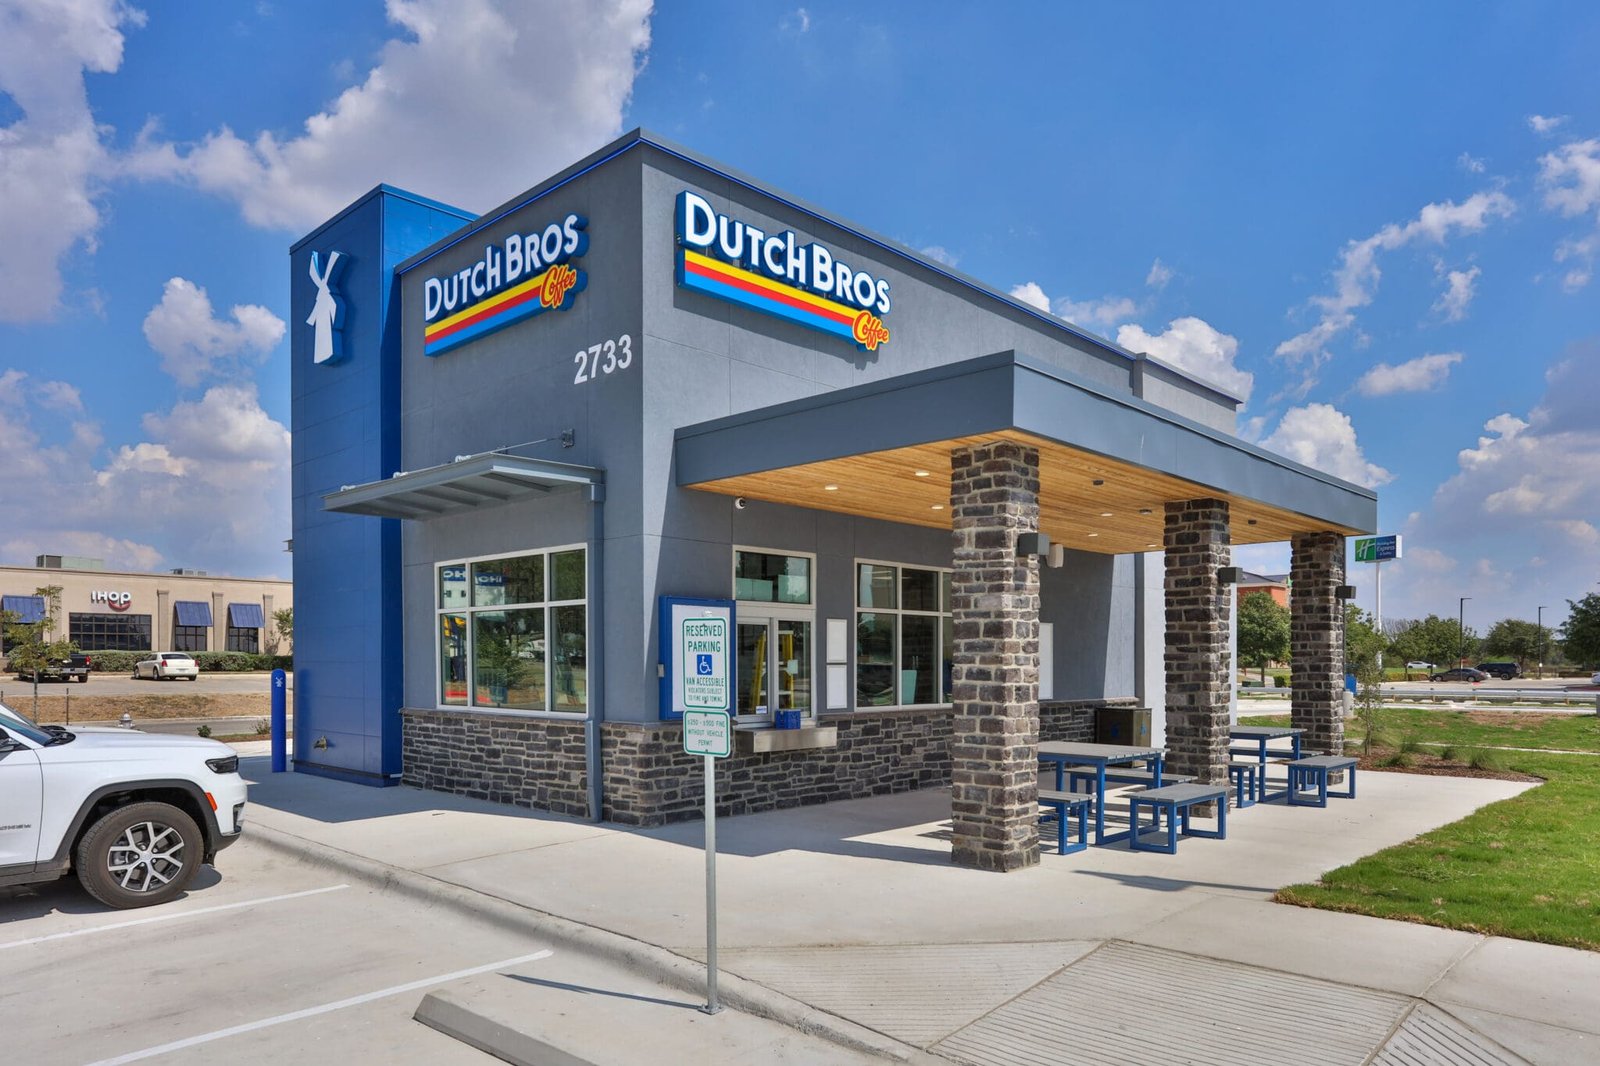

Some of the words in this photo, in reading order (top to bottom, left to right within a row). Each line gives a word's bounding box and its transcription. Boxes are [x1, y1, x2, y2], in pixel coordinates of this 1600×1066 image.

[424, 246, 500, 322] DUTCH
[505, 214, 579, 283] BROS
[685, 191, 806, 285] DUTCH
[813, 243, 891, 314] BROS
[540, 265, 577, 308] Coffee
[853, 312, 889, 350] Coffee
[573, 334, 633, 385] 2733
[685, 625, 722, 637] RESERVED
[688, 640, 721, 653] PARKING
[686, 677, 695, 685] VAN
[697, 677, 724, 687] ACCESSIBLE
